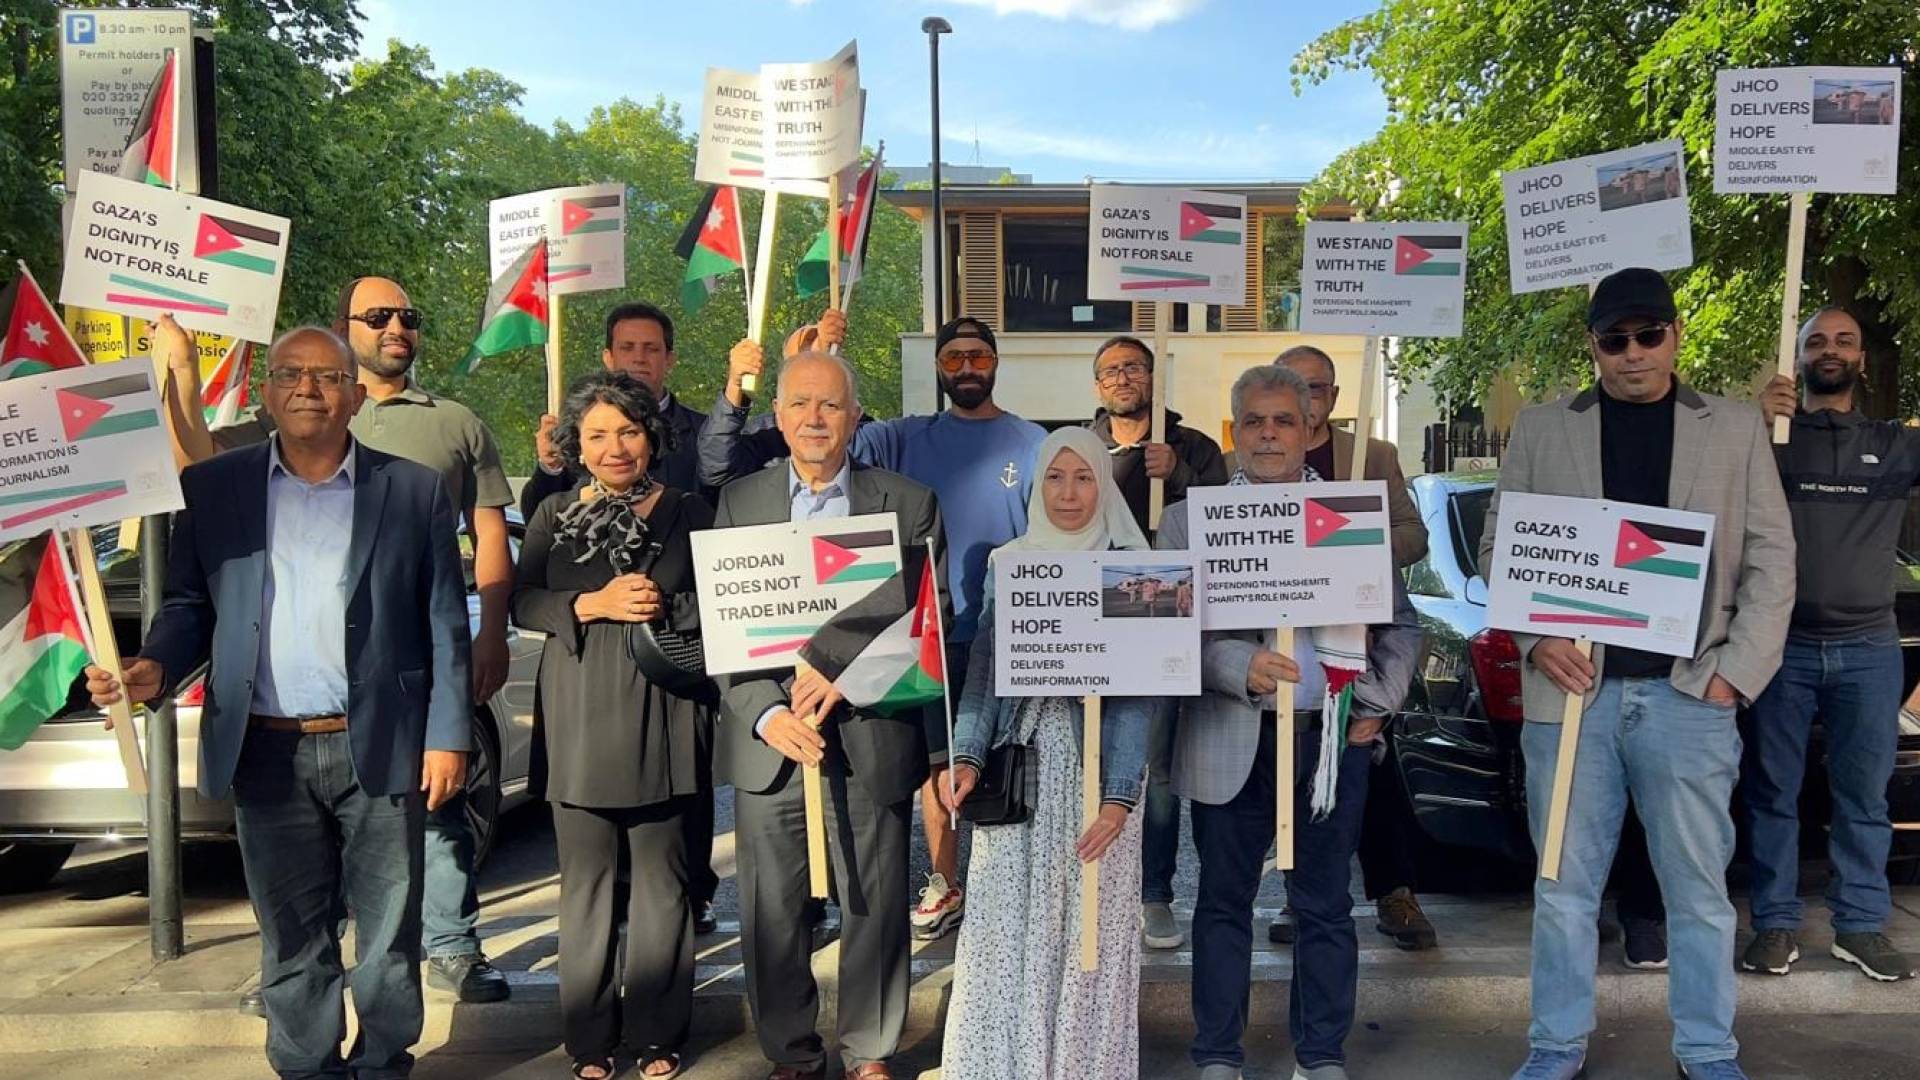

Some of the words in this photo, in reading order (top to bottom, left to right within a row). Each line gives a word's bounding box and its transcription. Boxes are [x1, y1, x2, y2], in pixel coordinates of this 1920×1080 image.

[73, 18, 92, 42] P
[128, 25, 145, 34] am
[154, 23, 166, 34] 10
[169, 25, 186, 36] pm
[79, 49, 115, 60] Permit
[119, 49, 161, 60] holders
[121, 67, 133, 75] or
[91, 81, 111, 91] Pay
[114, 81, 128, 91] by
[131, 81, 152, 91] pho
[774, 78, 797, 91] WE
[1731, 79, 1779, 93] JHCO
[82, 92, 106, 101] 020
[717, 86, 763, 102] MIDDL
[83, 106, 126, 116] quoting
[715, 104, 749, 120] EAST
[774, 99, 812, 112] WITH
[1730, 102, 1810, 116] DELIVERS
[776, 121, 822, 134] TRUTH
[1729, 126, 1776, 139] HOPE
[88, 147, 108, 159] Pay
[111, 148, 123, 158] at
[1728, 146, 1766, 155] MIDDLE
[1769, 146, 1795, 155] EAST
[1797, 146, 1815, 155] EYE
[93, 162, 120, 174] Disp
[1728, 161, 1777, 170] DELIVERS
[1518, 173, 1563, 195] JHCO
[1728, 175, 1817, 185] MISINFORMATION
[1519, 191, 1597, 217] DELIVERS
[92, 200, 158, 227] GAZA'S
[499, 207, 540, 223] MIDDLE
[1102, 207, 1150, 221] GAZA'S
[499, 228, 525, 241] EAST
[527, 224, 547, 237] EYE
[1102, 227, 1155, 241] DIGNITY
[1157, 230, 1169, 241] IS
[1522, 221, 1566, 240] HOPE
[88, 223, 162, 251] DIGNITY
[163, 240, 180, 255] IS
[1316, 237, 1341, 250] WE
[1343, 237, 1393, 250] STAND
[1524, 243, 1561, 256] MIDDLE
[1563, 238, 1587, 251] EAST
[1588, 234, 1608, 246] EYE
[1101, 247, 1130, 259] NOT
[1131, 248, 1159, 260] FOR
[1160, 249, 1193, 262] SALE
[84, 246, 127, 266] NOT
[127, 255, 163, 275] FOR
[164, 264, 209, 285] SALE
[1315, 259, 1355, 271] WITH
[1357, 259, 1386, 271] THE
[1525, 255, 1572, 270] DELIVERS
[1526, 262, 1614, 283] MISINFORMATION
[1315, 280, 1363, 292] TRUTH
[75, 320, 111, 335] Parking
[2, 427, 39, 448] EYE
[67, 445, 79, 456] IS
[1800, 483, 1817, 491] THE
[1818, 484, 1847, 493] NORTH
[1847, 485, 1868, 493] FACE
[1204, 505, 1235, 520] WE
[1237, 502, 1300, 519] STAND
[1514, 520, 1577, 540] GAZA'S
[1205, 531, 1254, 547] WITH
[1256, 529, 1294, 545] THE
[712, 552, 785, 573] JORDAN
[1511, 544, 1583, 565] DIGNITY
[1583, 552, 1600, 567] IS
[1010, 564, 1064, 579] JHCO
[1205, 557, 1268, 574] TRUTH
[714, 581, 761, 597] DOES
[764, 575, 801, 592] NOT
[1207, 581, 1259, 591] DEFENDING
[1260, 579, 1278, 589] THE
[1279, 577, 1331, 588] HASHEMITE
[1508, 567, 1546, 584] NOT
[1548, 571, 1583, 589] FOR
[1585, 576, 1630, 596] SALE
[1011, 591, 1099, 607] DELIVERS
[1255, 592, 1279, 603] ROLE
[1280, 592, 1290, 601] IN
[1290, 591, 1315, 601] GAZA
[717, 603, 774, 622] TRADE
[777, 602, 795, 617] IN
[798, 598, 838, 614] PAIN
[1011, 619, 1062, 634] HOPE
[1010, 643, 1054, 654] MIDDLE
[1056, 643, 1085, 653] EAST
[1086, 643, 1107, 653] EYE
[1010, 660, 1064, 670] DELIVERS
[1010, 675, 1110, 686] MISINFORMATION
